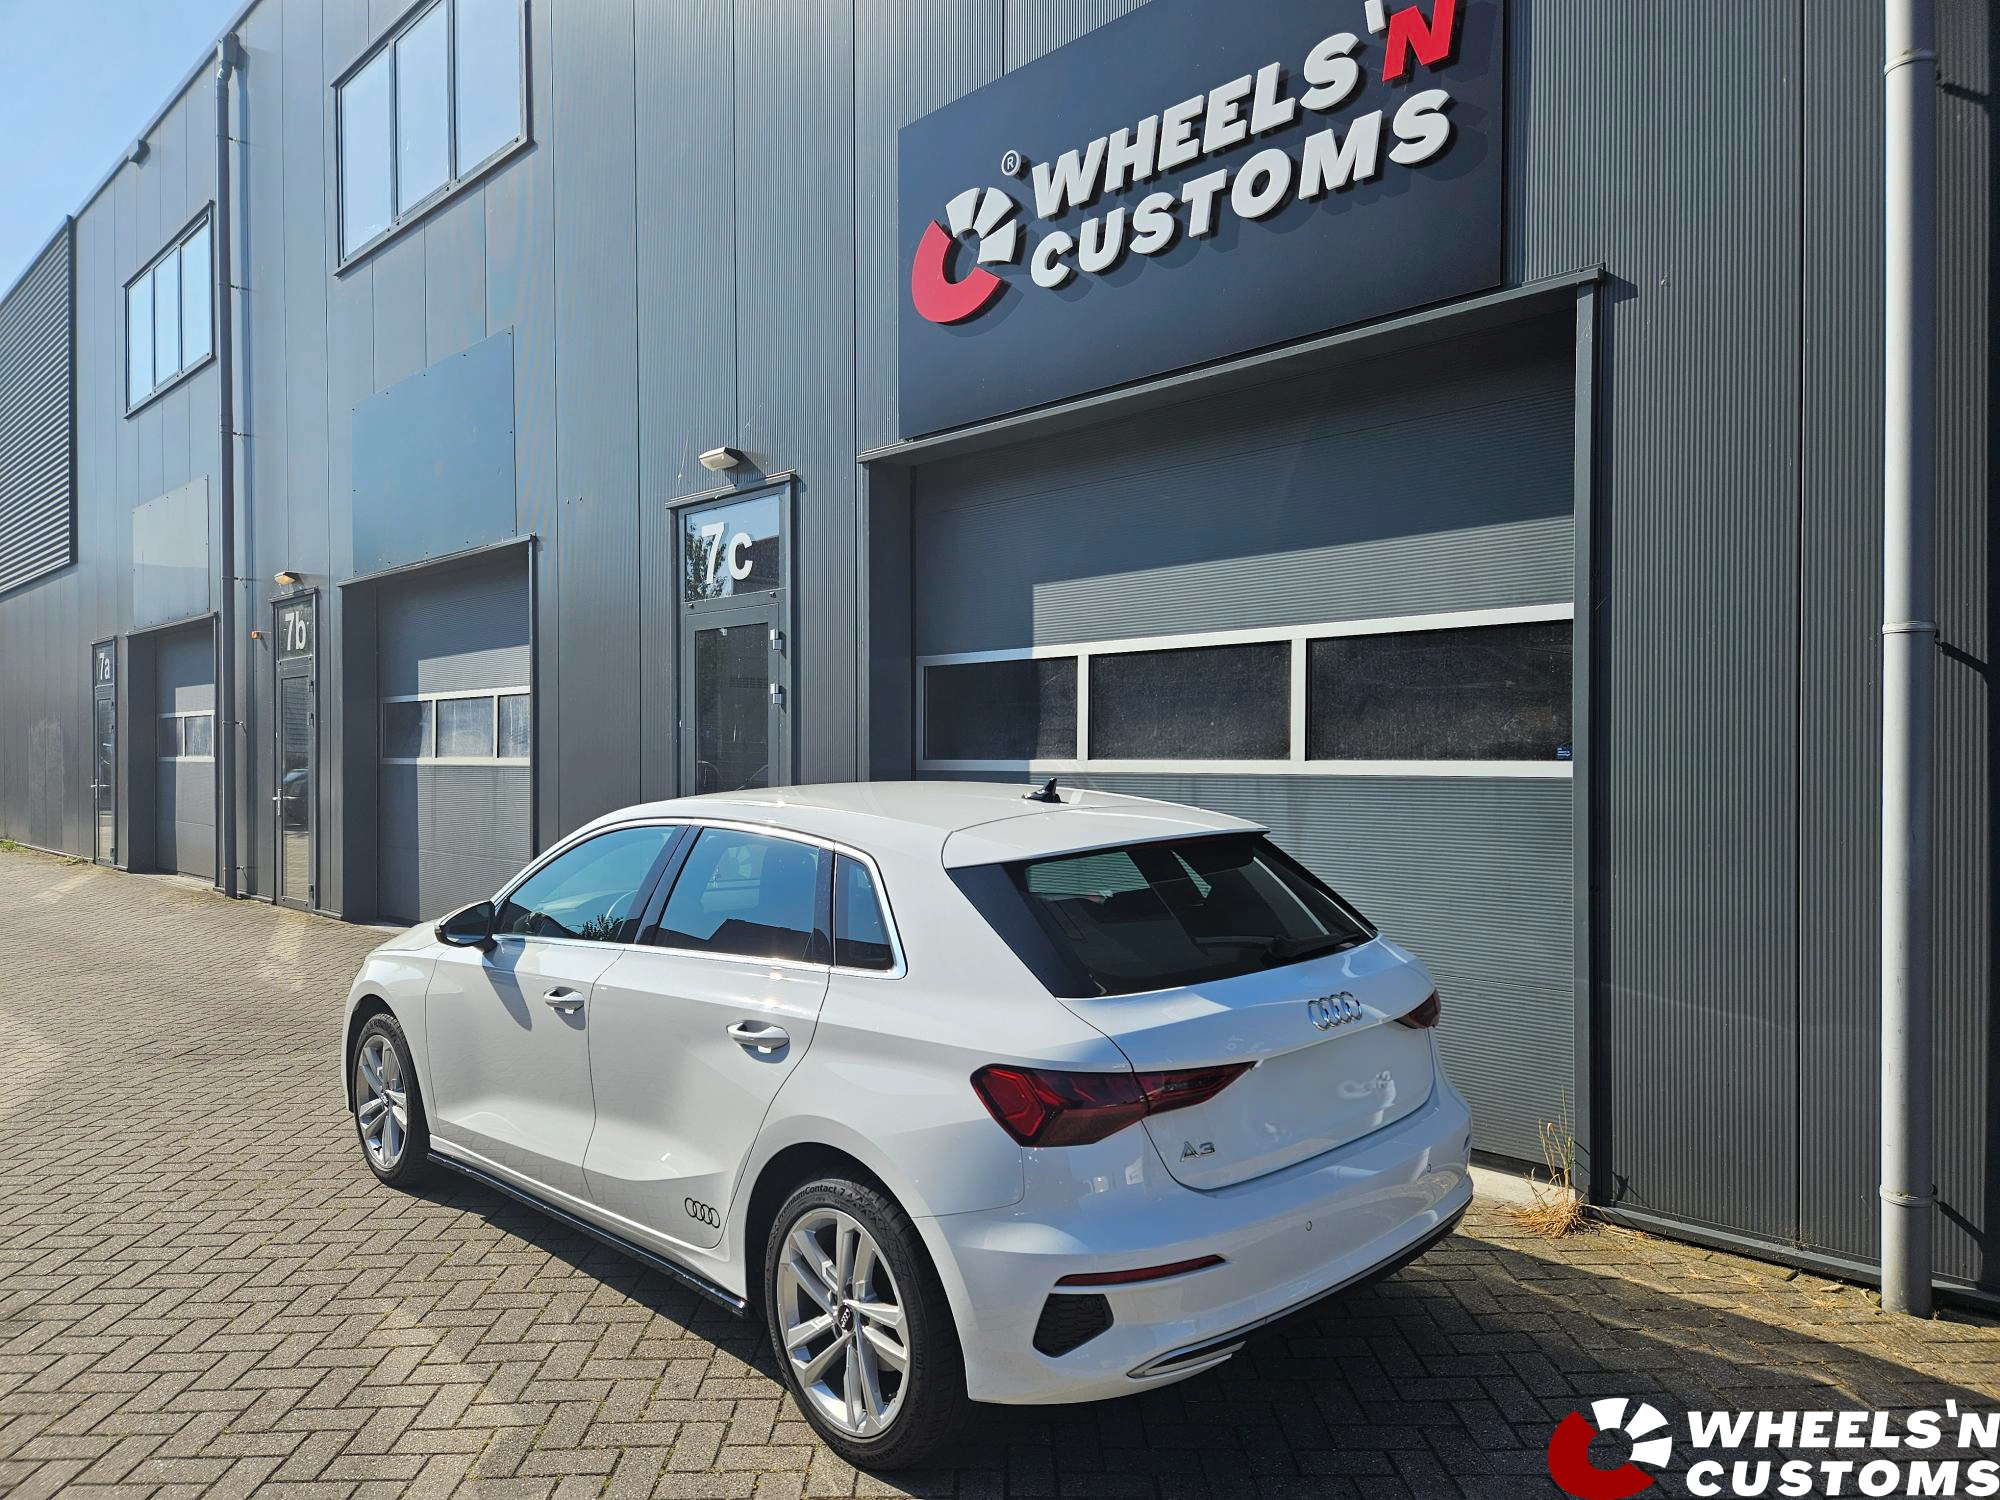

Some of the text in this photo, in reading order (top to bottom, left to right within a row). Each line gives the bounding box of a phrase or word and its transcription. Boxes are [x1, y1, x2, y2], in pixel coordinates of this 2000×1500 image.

[1031, 89, 1452, 287] CUSTOMS
[701, 521, 753, 584] 7c
[284, 612, 306, 650] 7b
[99, 652, 110, 680] 7a
[1180, 1141, 1215, 1162] A3
